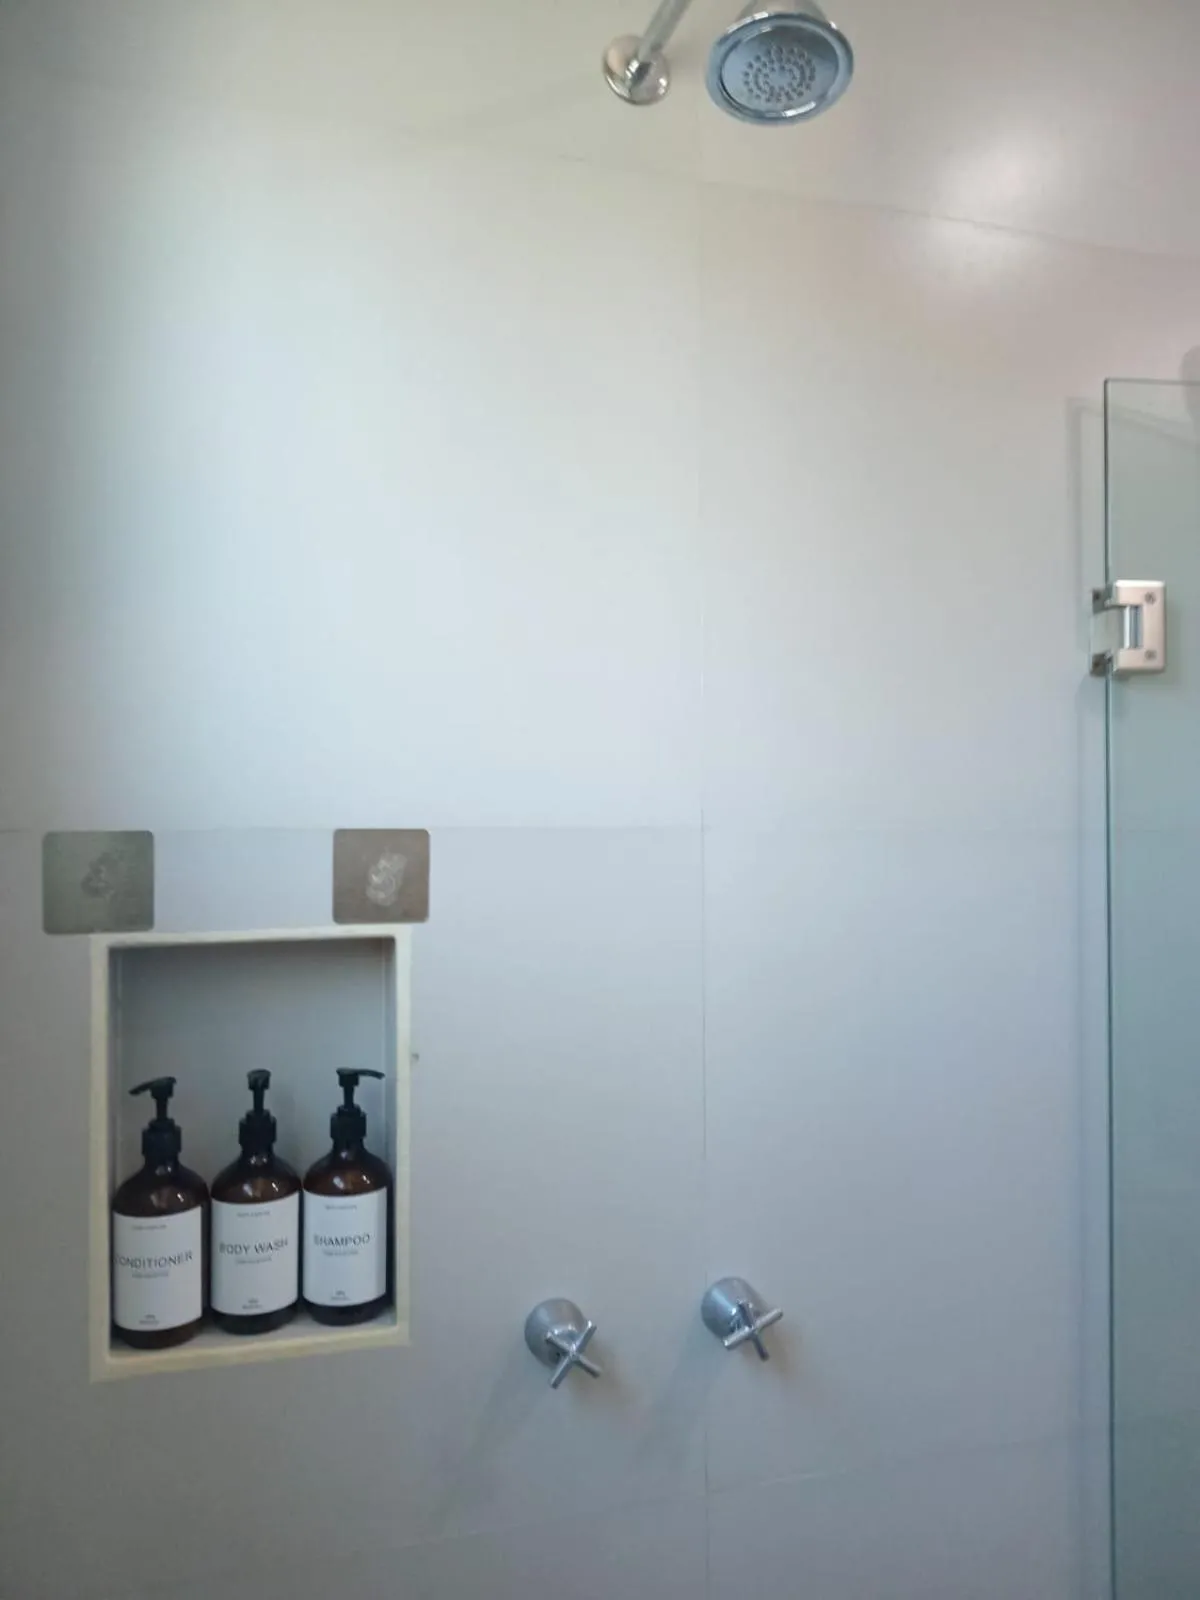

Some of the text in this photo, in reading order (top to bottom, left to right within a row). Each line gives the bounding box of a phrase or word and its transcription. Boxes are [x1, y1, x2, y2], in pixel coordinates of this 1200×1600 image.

[219, 1238, 288, 1255] BODY WASH
[314, 1234, 370, 1246] SHAMPOO
